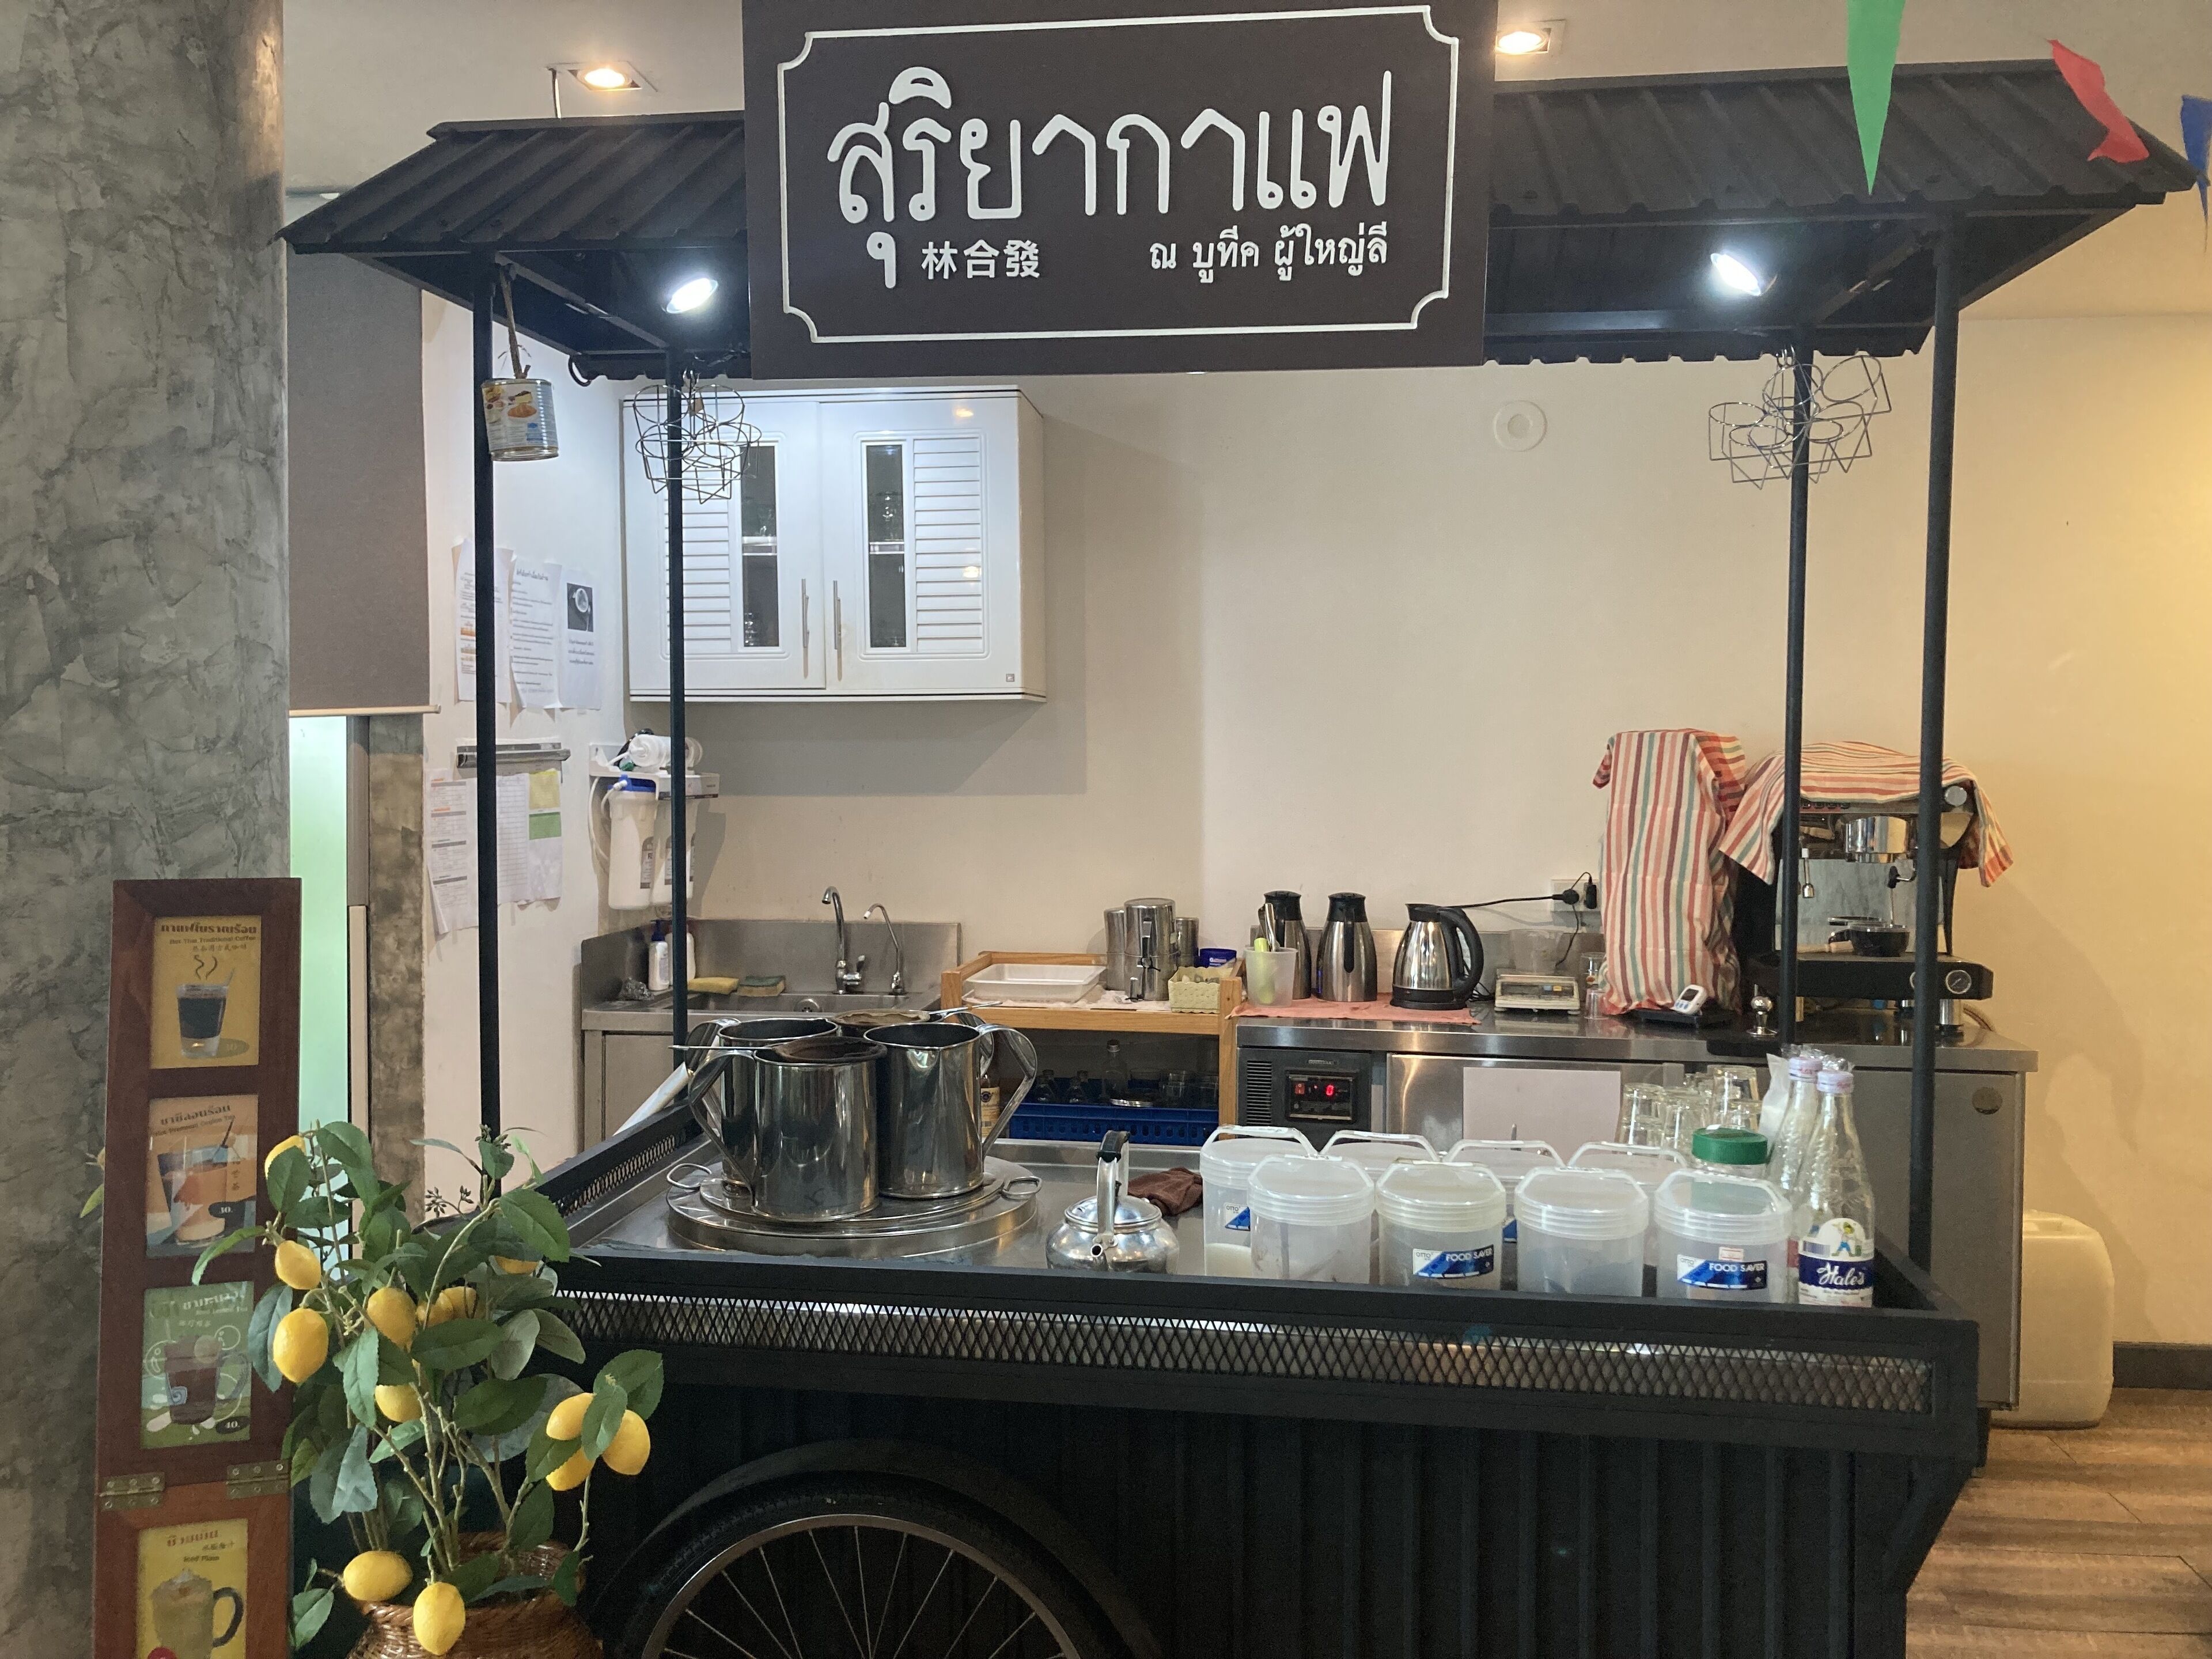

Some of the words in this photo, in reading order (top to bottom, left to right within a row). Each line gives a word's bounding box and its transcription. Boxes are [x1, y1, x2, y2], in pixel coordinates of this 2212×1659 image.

[827, 65, 1392, 290] สุริยากาแฟ
[921, 239, 1040, 280] 林合發
[1150, 242, 1176, 270] ณ
[1192, 225, 1259, 283] บูทีค
[1274, 221, 1388, 281] ผู้ใหญ่ลี
[1445, 1253, 1472, 1262] FOOD
[1473, 1247, 1493, 1259] SAVER
[1709, 1262, 1737, 1272] FOOD
[1740, 1262, 1765, 1272] SAVER
[1816, 1262, 1865, 1286] Hale's
